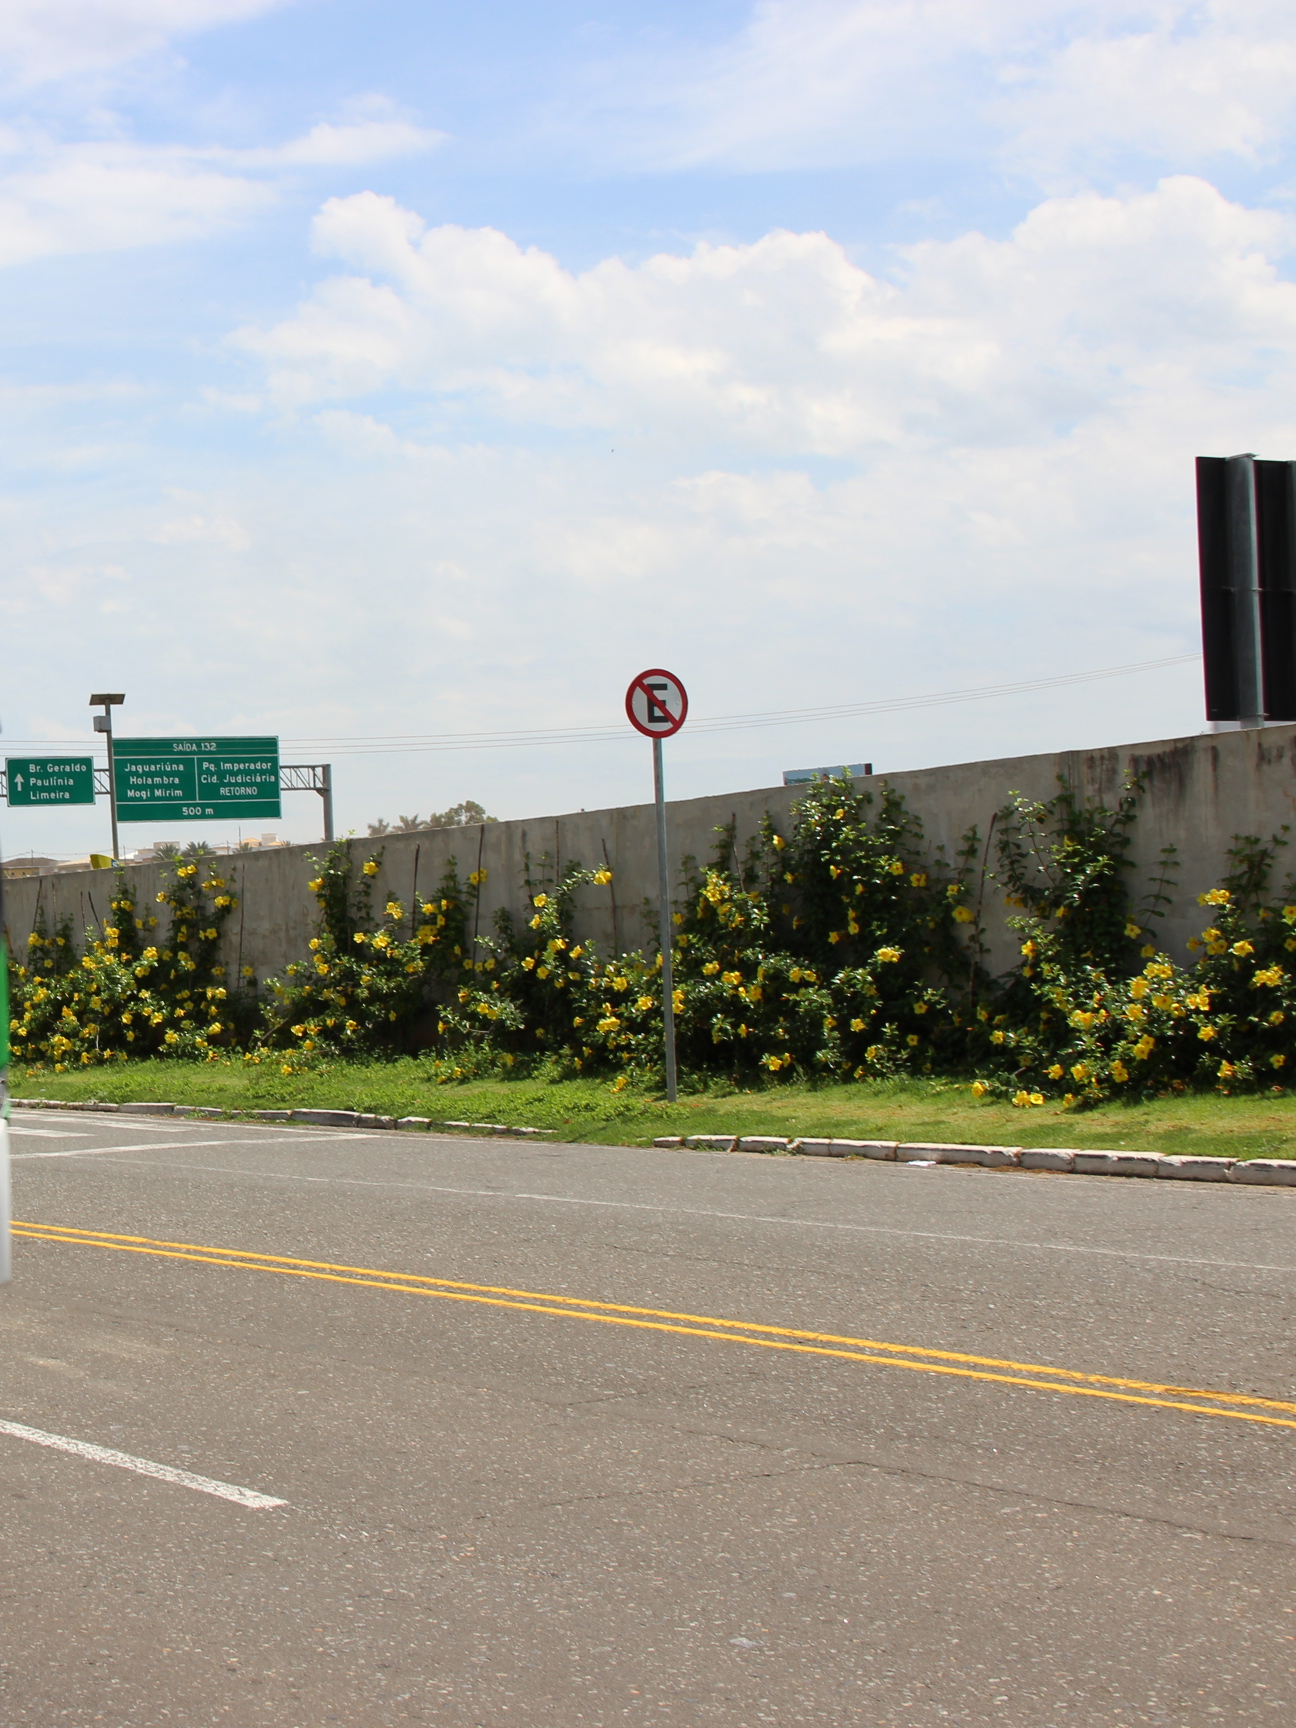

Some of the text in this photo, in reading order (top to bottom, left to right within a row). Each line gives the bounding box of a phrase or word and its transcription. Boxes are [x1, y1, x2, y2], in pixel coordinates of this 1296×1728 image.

[172, 741, 217, 752] SAÍDA 132
[29, 763, 87, 773] Br. Geraldo
[124, 762, 184, 774] Jaguariúna
[202, 761, 272, 772] Pq. Imperador
[29, 776, 74, 787] Paulínia
[129, 775, 180, 785] Holambra
[201, 772, 276, 784] Cid. Judiciária
[30, 791, 70, 800] Limeira
[127, 788, 183, 800] Mogi Mirim
[219, 786, 258, 796] RETORNO
[182, 806, 202, 816] 500
